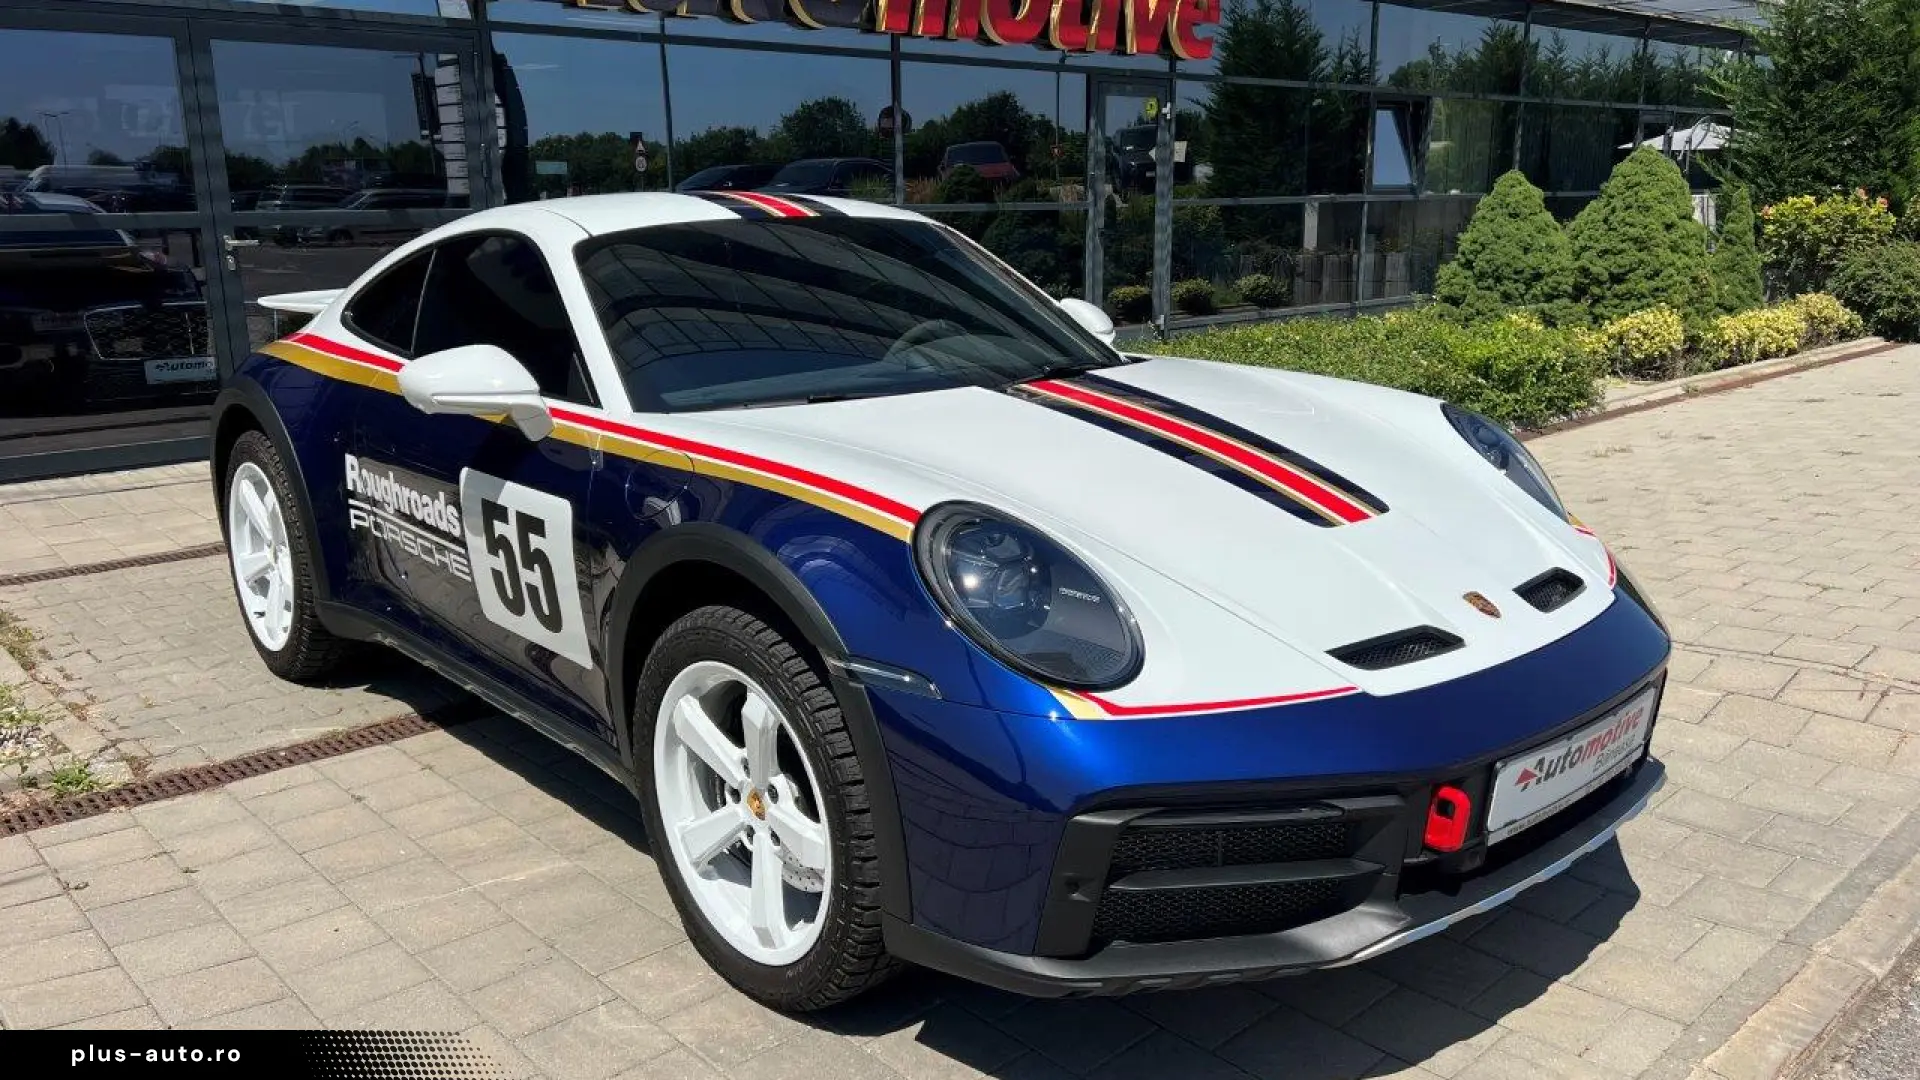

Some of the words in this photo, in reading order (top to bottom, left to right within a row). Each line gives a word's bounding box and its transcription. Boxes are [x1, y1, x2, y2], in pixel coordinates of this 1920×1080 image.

[345, 453, 462, 537] Roughroads
[350, 509, 472, 583] PORSCHE
[481, 498, 562, 634] 55
[1515, 706, 1644, 792] Automotive
